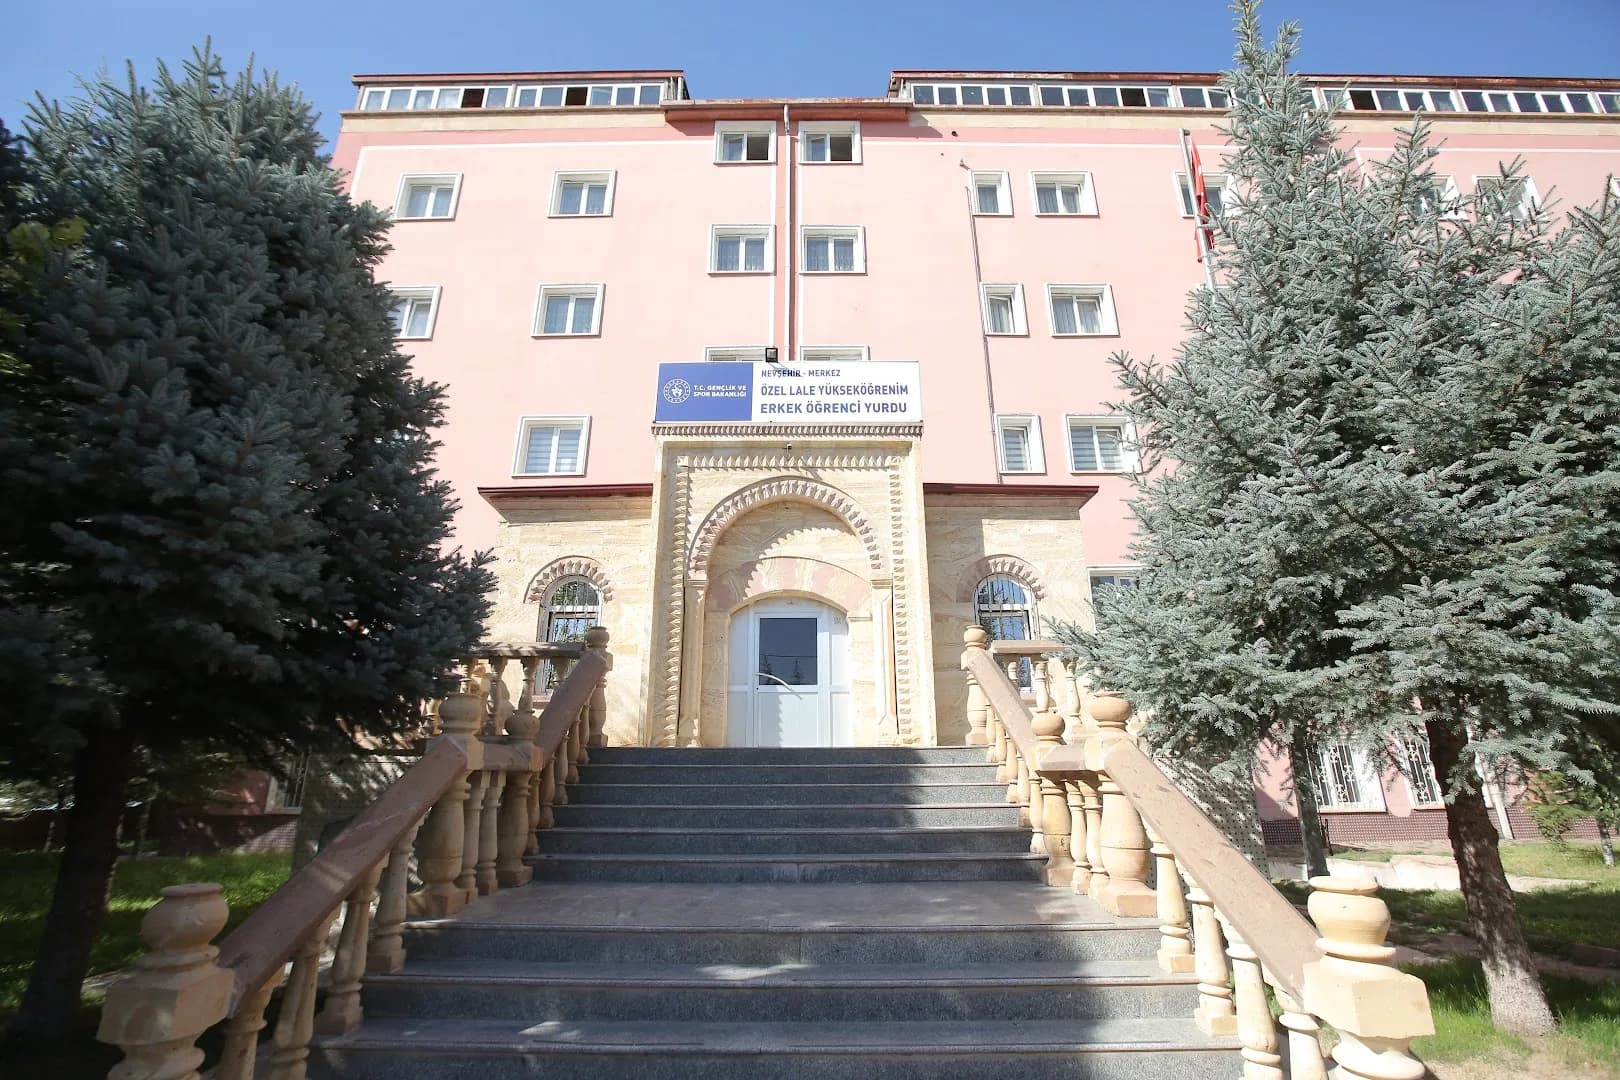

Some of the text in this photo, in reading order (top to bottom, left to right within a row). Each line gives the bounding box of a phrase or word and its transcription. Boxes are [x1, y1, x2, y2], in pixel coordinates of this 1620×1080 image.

[808, 369, 841, 377] MERKEZ
[707, 384, 737, 392] GENÇLİK
[761, 382, 909, 396] ÖZEL LALE YÜKSEKÖĞRENİM
[711, 390, 747, 398] BAKANLIĞI
[760, 400, 907, 414] ERKEK ÖĞRENCİ YURDU
